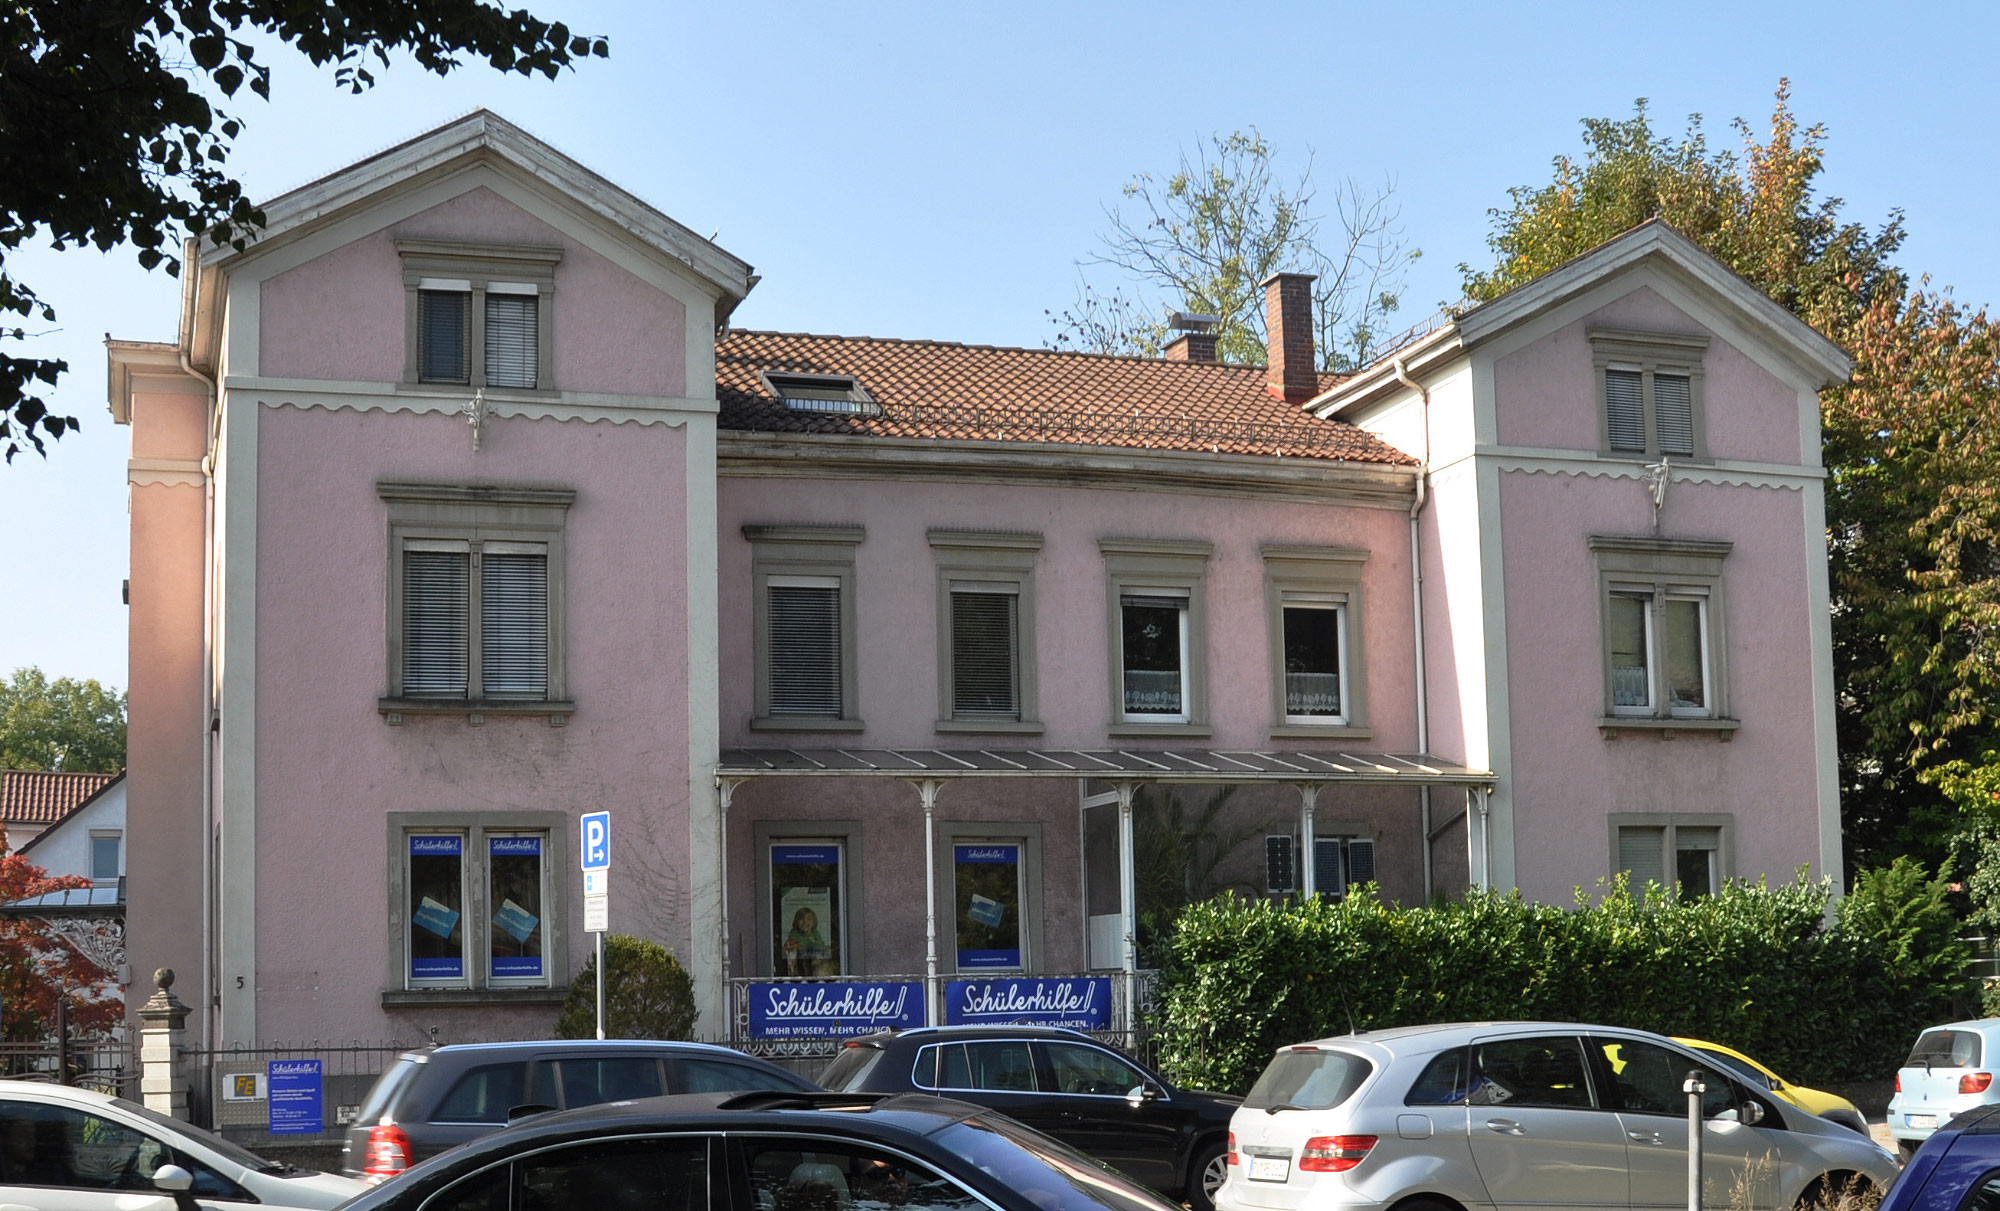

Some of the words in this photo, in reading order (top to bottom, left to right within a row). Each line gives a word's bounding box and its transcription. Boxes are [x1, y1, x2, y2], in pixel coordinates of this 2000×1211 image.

[587, 820, 604, 863] P
[236, 976, 244, 989] 5
[765, 1027, 790, 1035] MEHR
[829, 1026, 855, 1035] MEHR
[236, 1076, 254, 1095] FE
